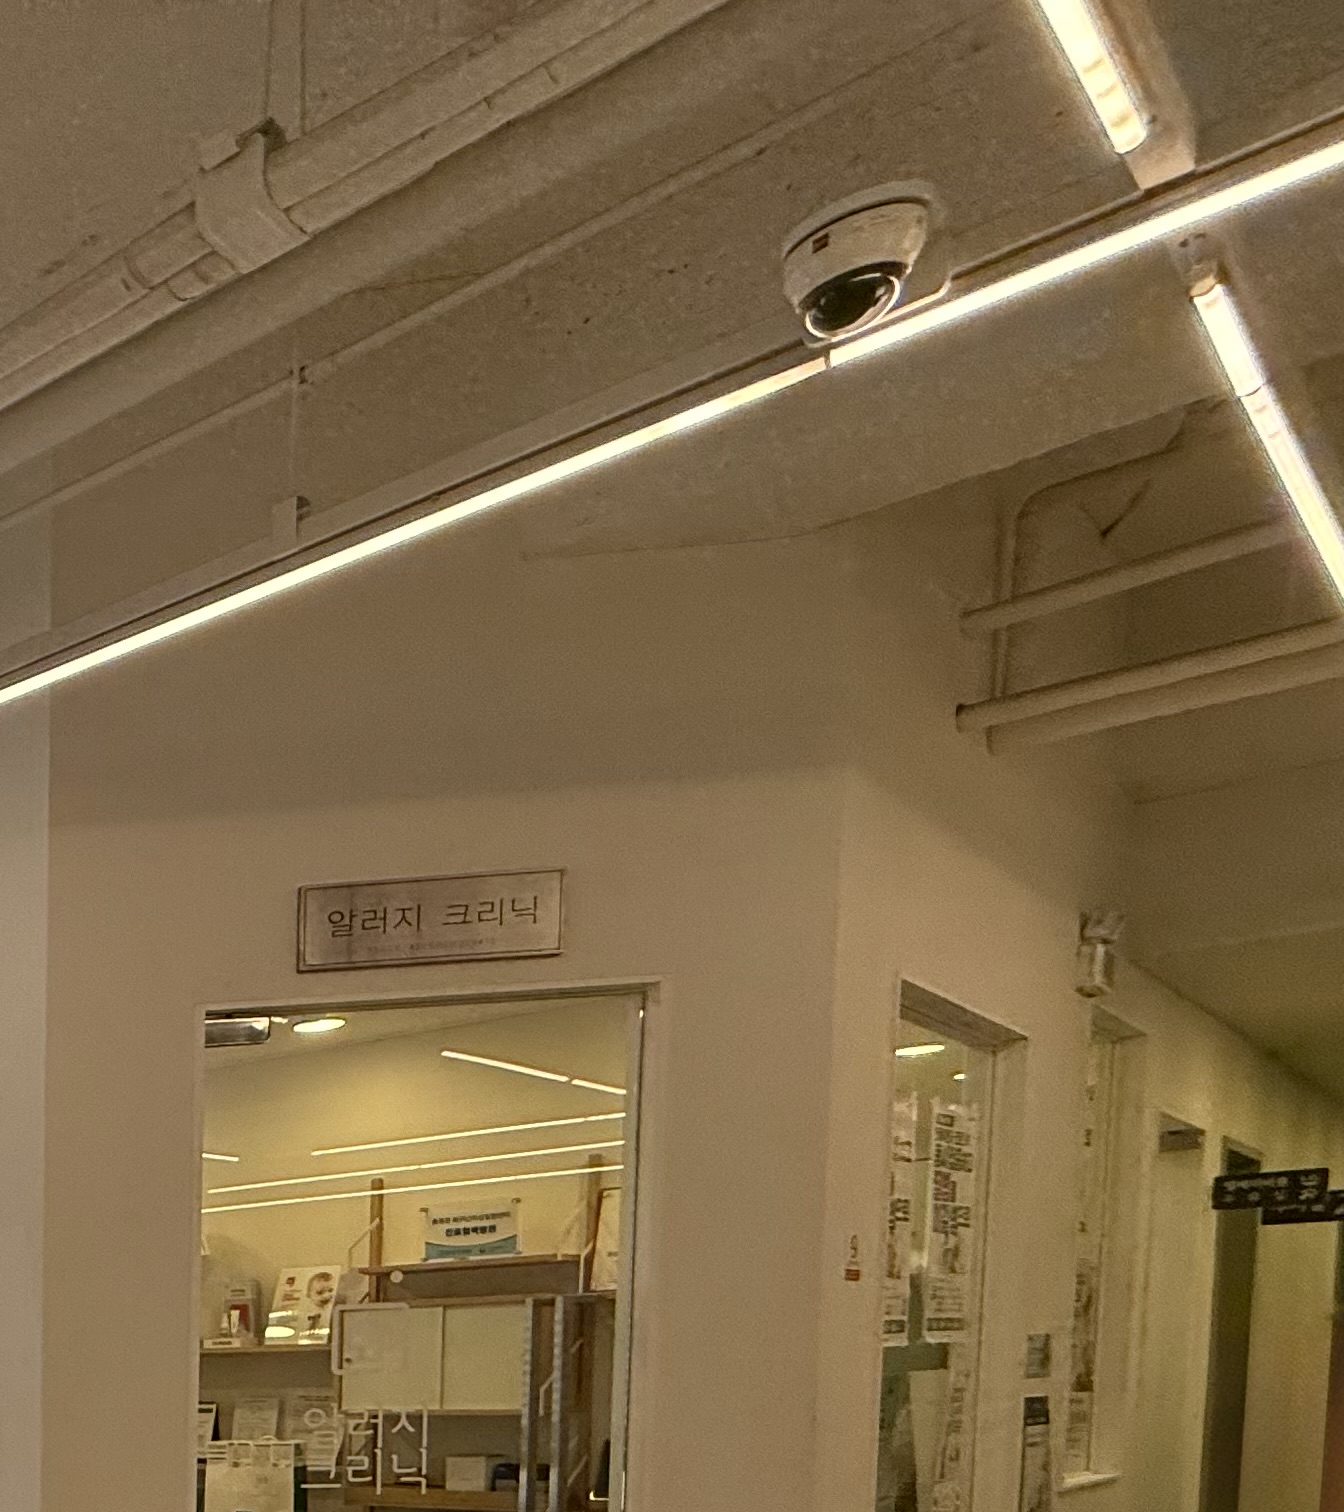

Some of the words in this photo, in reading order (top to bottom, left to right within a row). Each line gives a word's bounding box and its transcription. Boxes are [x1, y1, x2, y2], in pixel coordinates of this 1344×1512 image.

[328, 904, 421, 938] 알러지
[442, 895, 538, 927] 크리닉
[302, 1402, 428, 1449] 알러지
